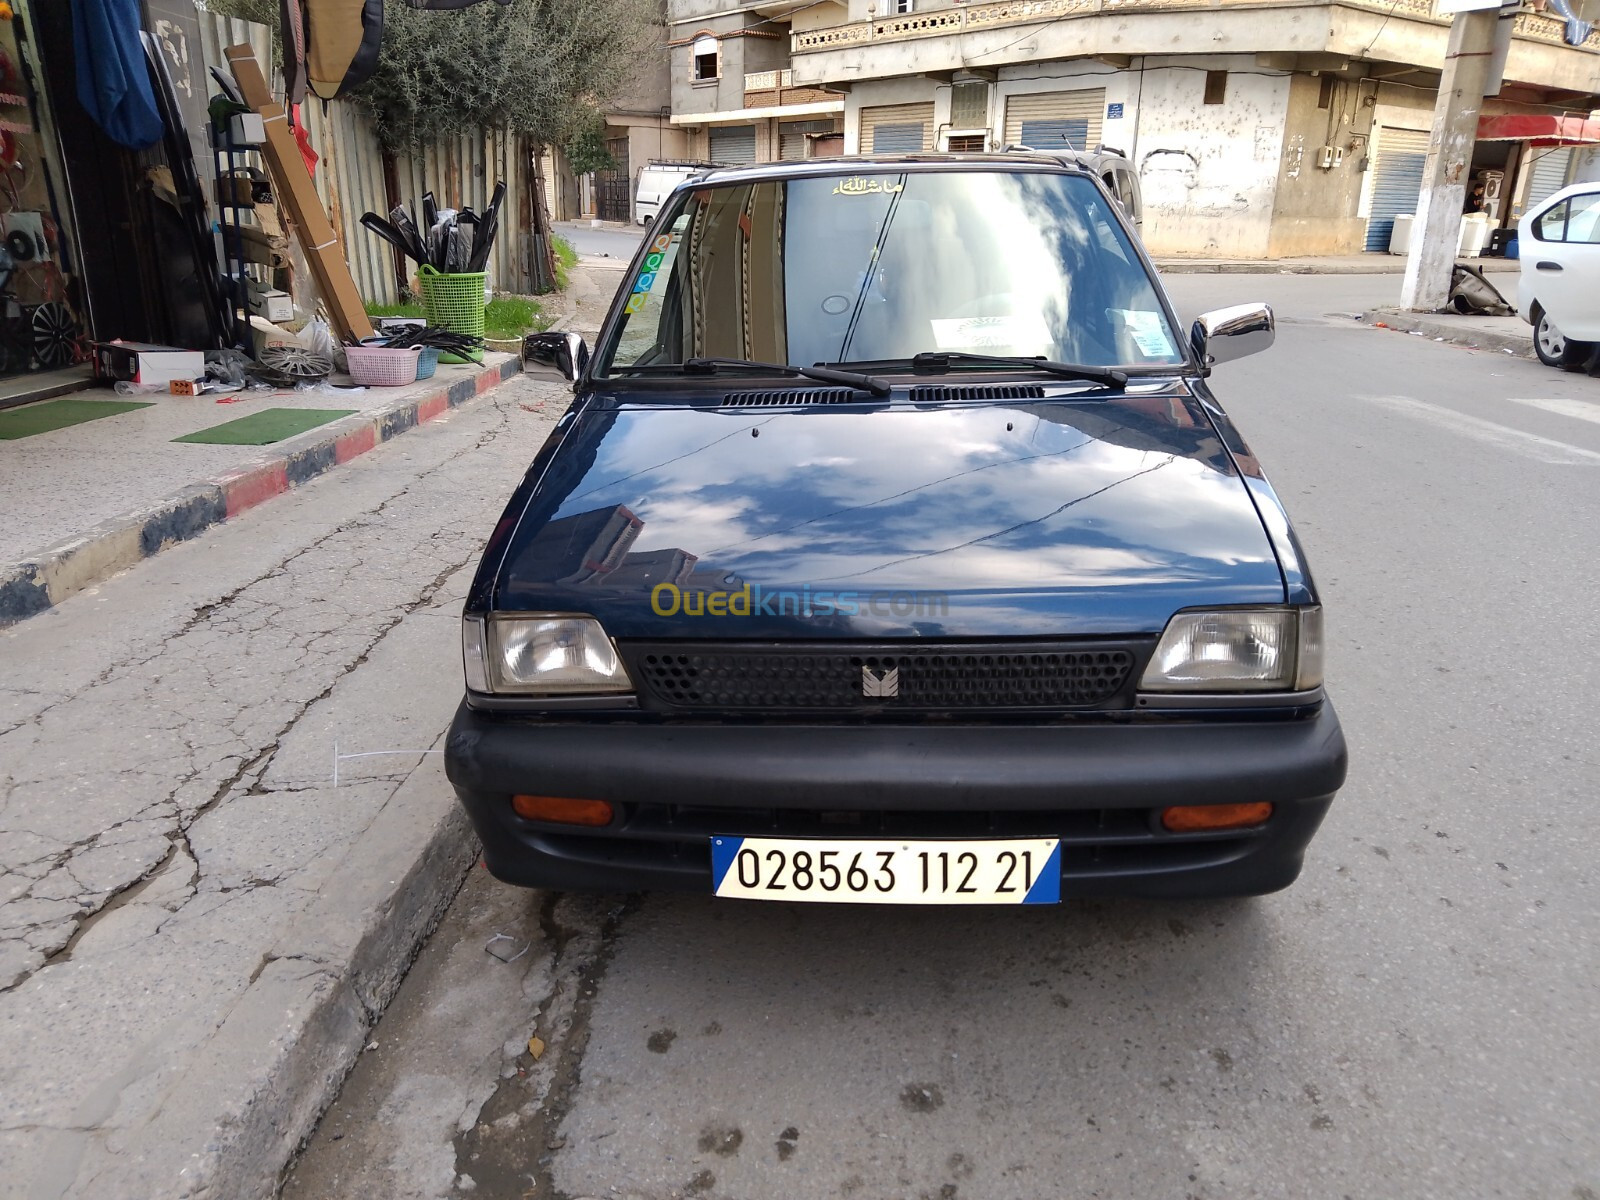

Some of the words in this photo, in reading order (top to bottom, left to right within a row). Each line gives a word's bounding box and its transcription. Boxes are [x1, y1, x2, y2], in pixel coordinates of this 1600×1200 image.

[655, 235, 669, 252] Q
[647, 254, 660, 270] Q
[637, 273, 652, 291] Q
[738, 849, 895, 891] 028563
[918, 851, 978, 893] 112
[995, 850, 1031, 893] 21
